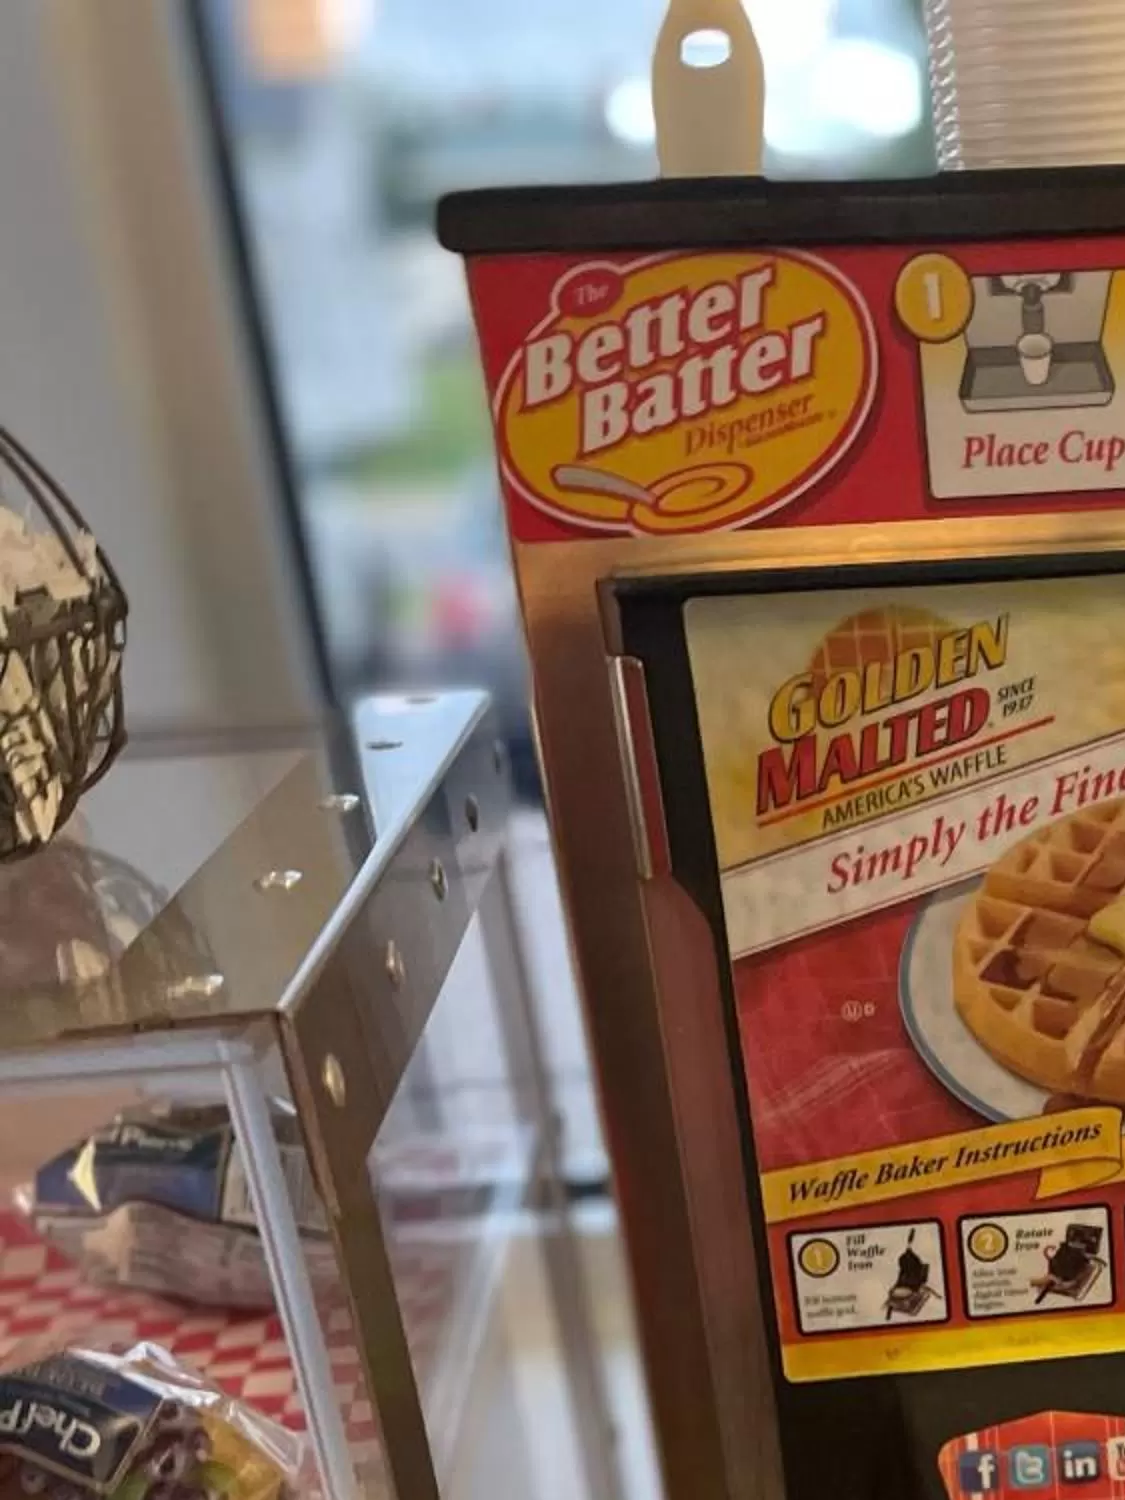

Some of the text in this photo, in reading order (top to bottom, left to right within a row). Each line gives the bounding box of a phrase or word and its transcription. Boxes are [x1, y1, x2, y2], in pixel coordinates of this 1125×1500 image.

[922, 271, 944, 321] 1
[523, 264, 776, 409] Better
[581, 312, 826, 455] Batter
[684, 393, 815, 458] Dispenser
[961, 431, 1050, 470] Place
[768, 611, 1011, 744] GOLDEN
[997, 676, 1037, 703] SINCE
[755, 685, 993, 817] MALTED
[822, 743, 1008, 830] AMERICA'S WAFFLE
[826, 815, 967, 895] Simply
[976, 793, 1040, 843] the
[787, 1121, 1103, 1204] Waffle Baker Instructions
[847, 1244, 886, 1258] Waffle
[1015, 1227, 1054, 1240] Rotate
[1063, 1451, 1097, 1478] in
